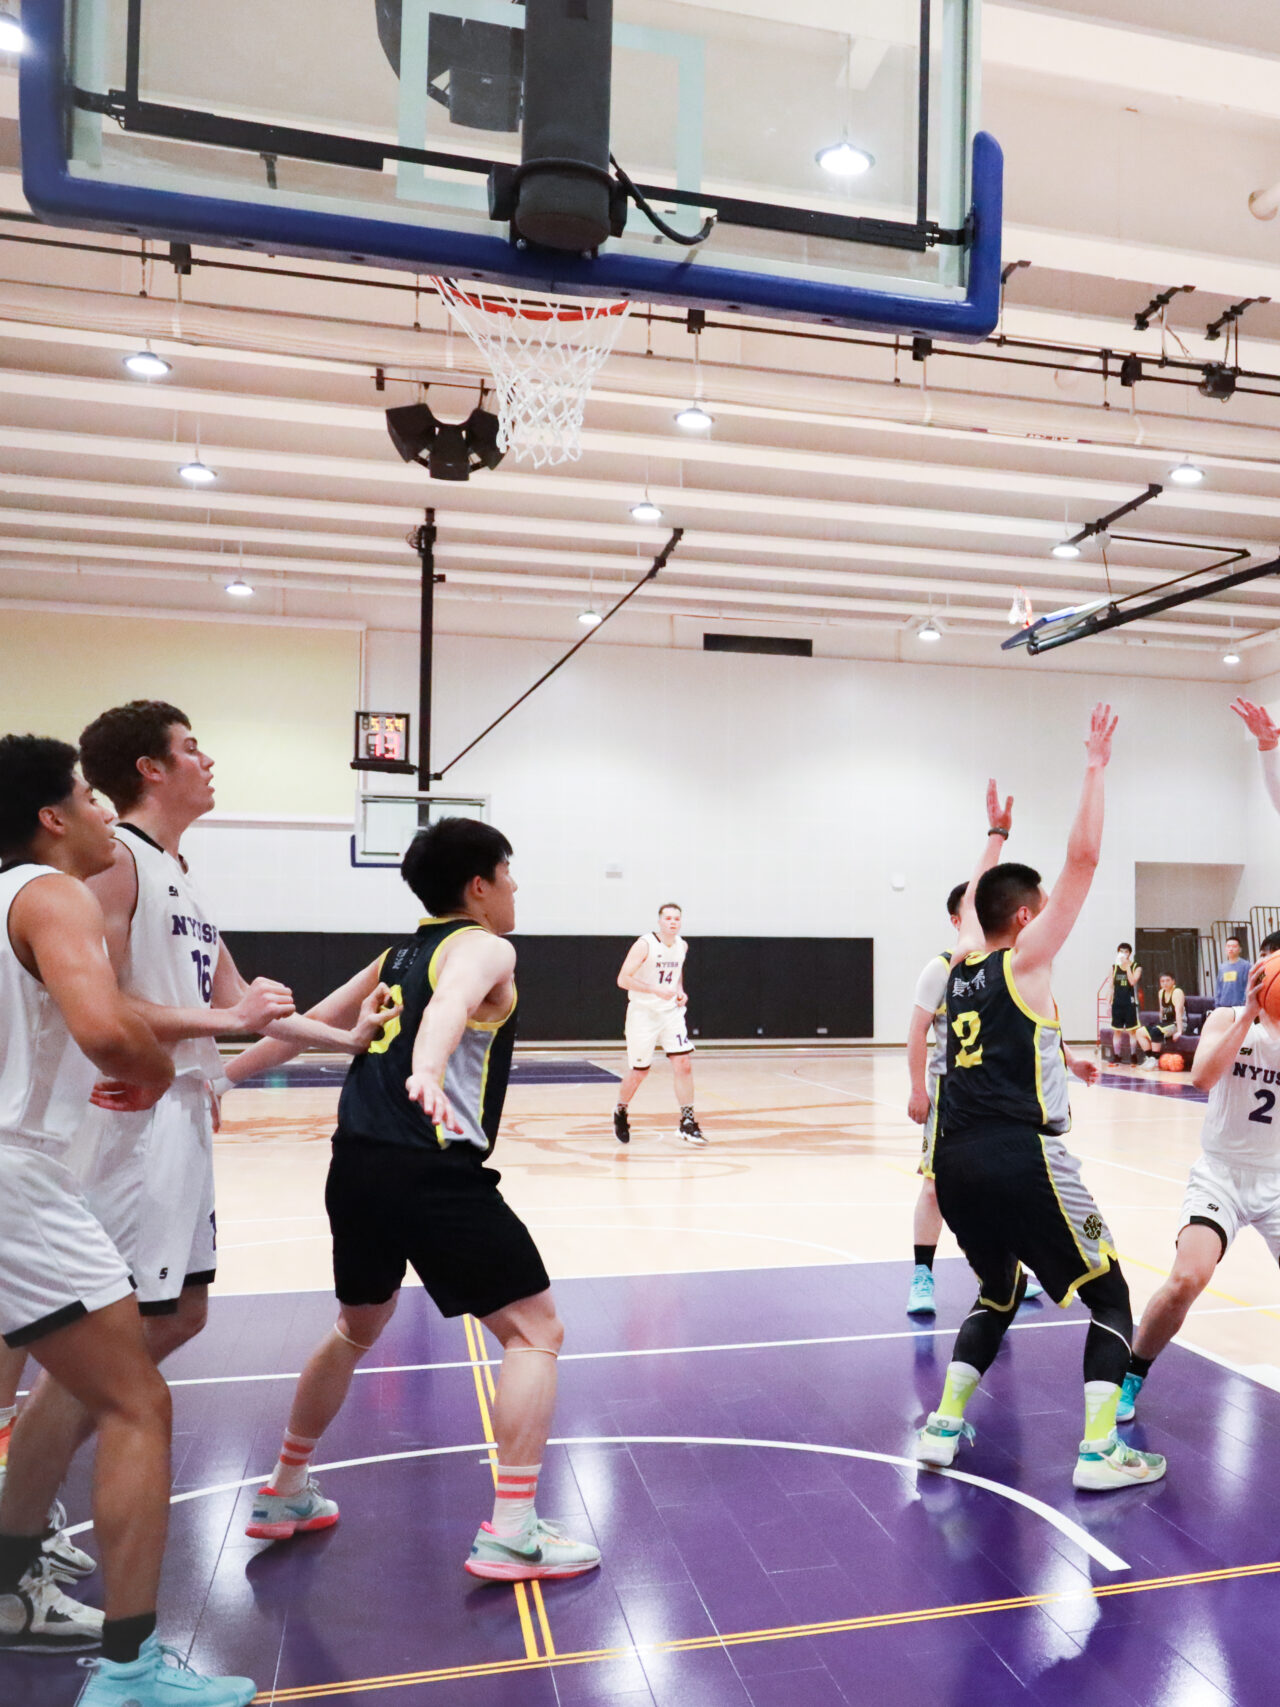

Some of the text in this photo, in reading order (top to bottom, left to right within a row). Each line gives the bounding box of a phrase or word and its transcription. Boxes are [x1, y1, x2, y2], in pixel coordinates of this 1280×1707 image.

[190, 949, 212, 1003] 16
[658, 970, 673, 984] 14
[951, 1010, 983, 1069] 2
[1248, 1088, 1276, 1125] 2
